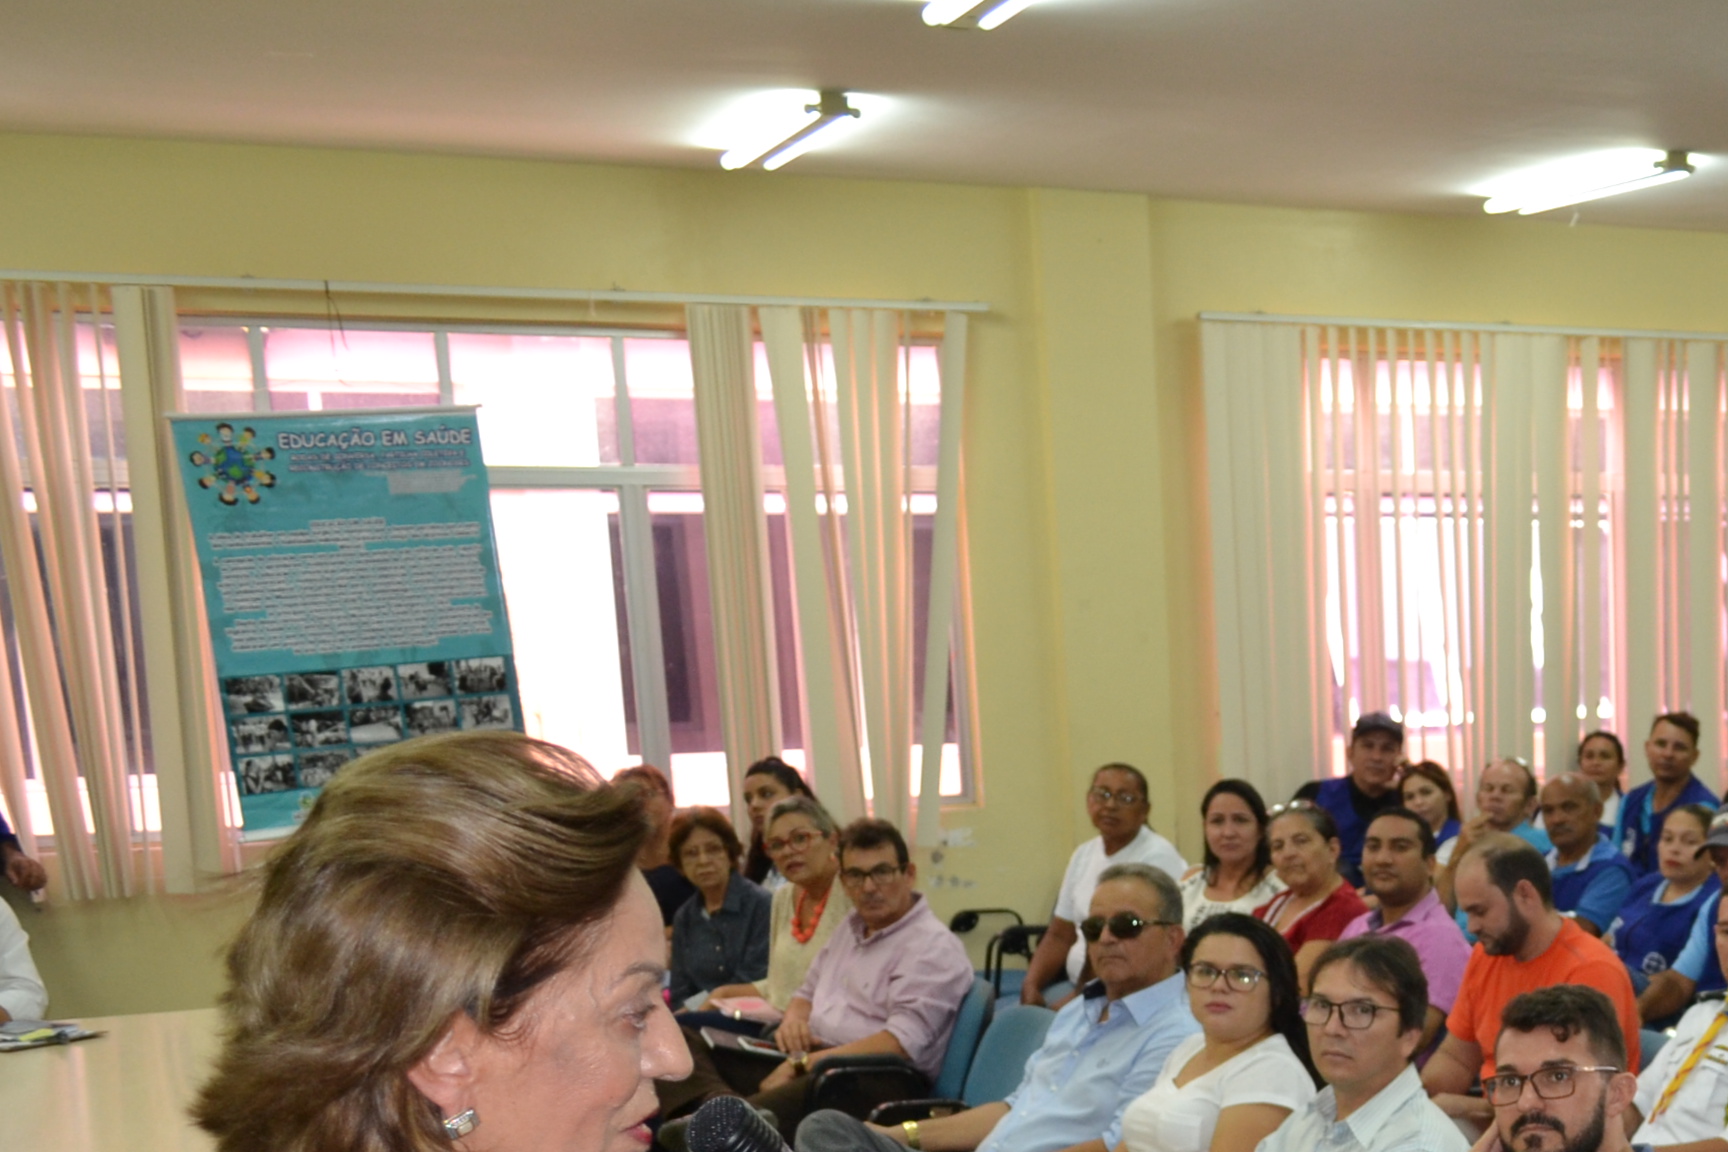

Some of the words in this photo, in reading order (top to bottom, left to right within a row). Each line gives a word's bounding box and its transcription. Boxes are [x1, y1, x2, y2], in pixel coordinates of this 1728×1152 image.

[278, 428, 375, 450] EDUCAÇÃO
[381, 430, 408, 447] EM
[414, 424, 472, 446] SAÚDE
